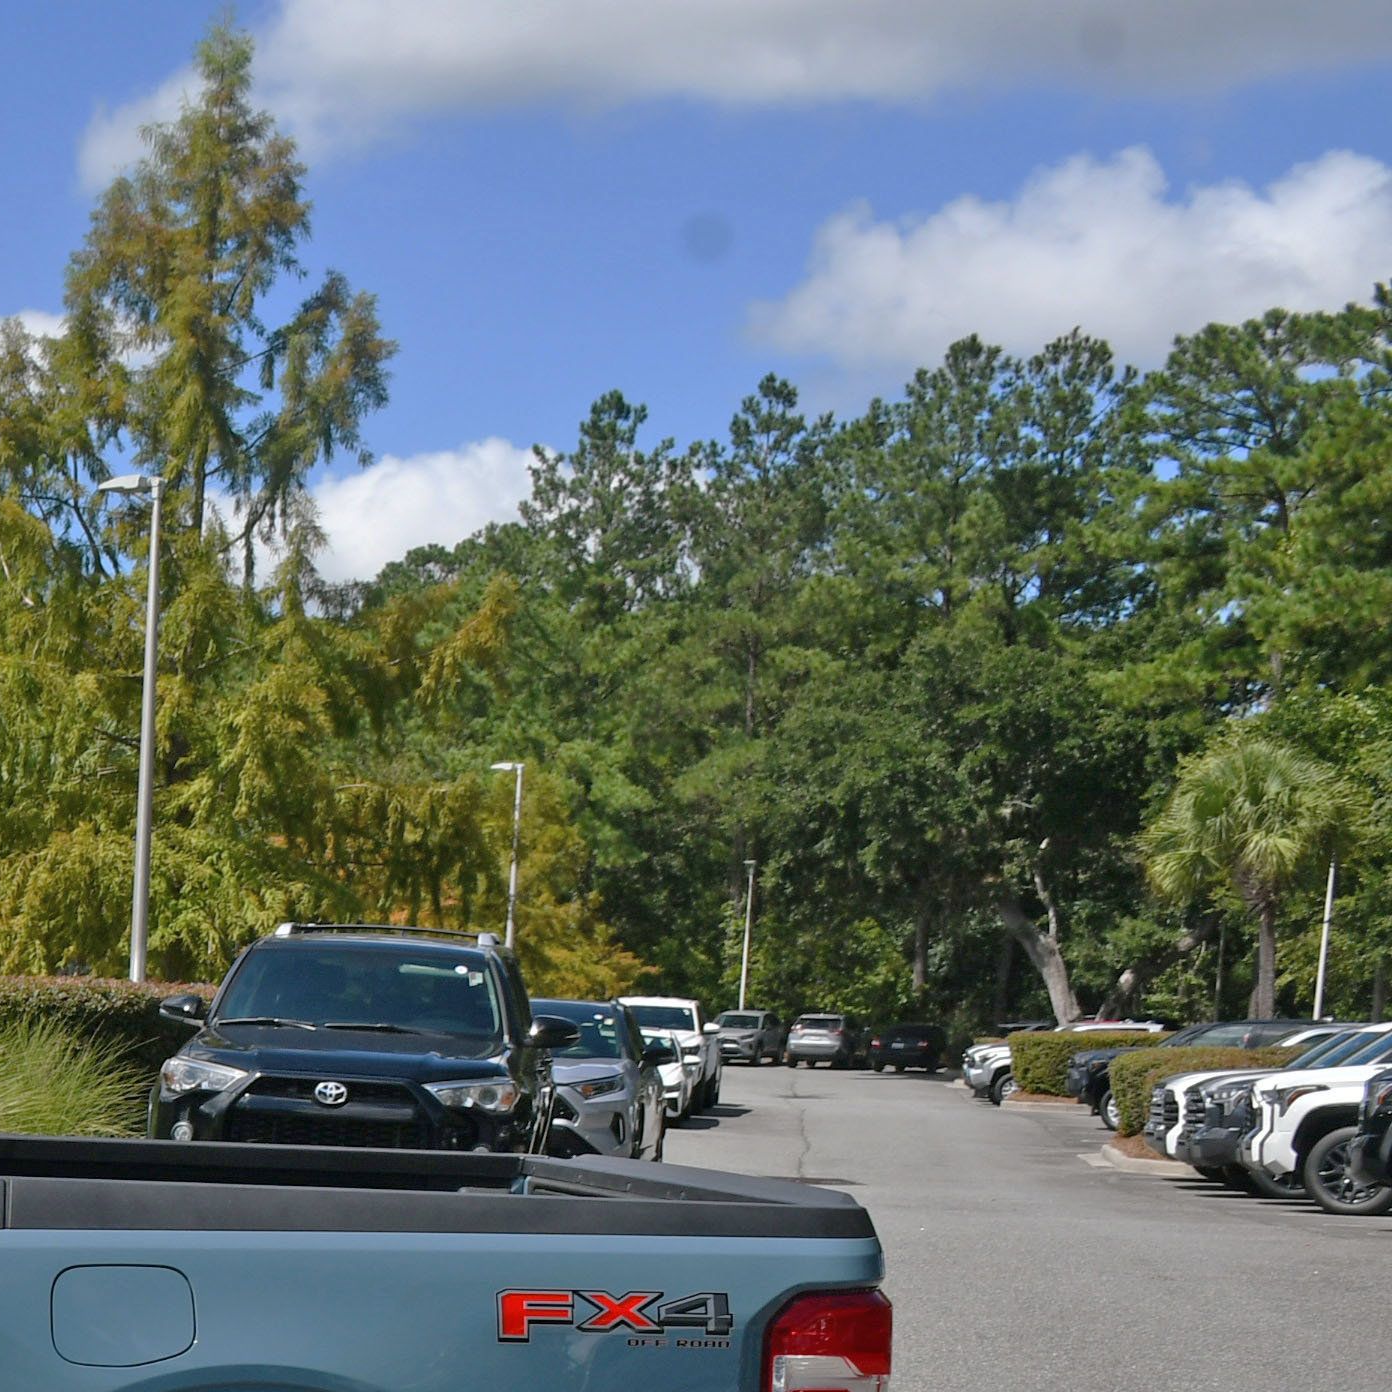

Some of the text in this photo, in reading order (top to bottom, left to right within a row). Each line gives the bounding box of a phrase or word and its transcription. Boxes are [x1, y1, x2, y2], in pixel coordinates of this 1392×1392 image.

[495, 1288, 734, 1343] FX4
[627, 1339, 730, 1348] OFF ROAD
